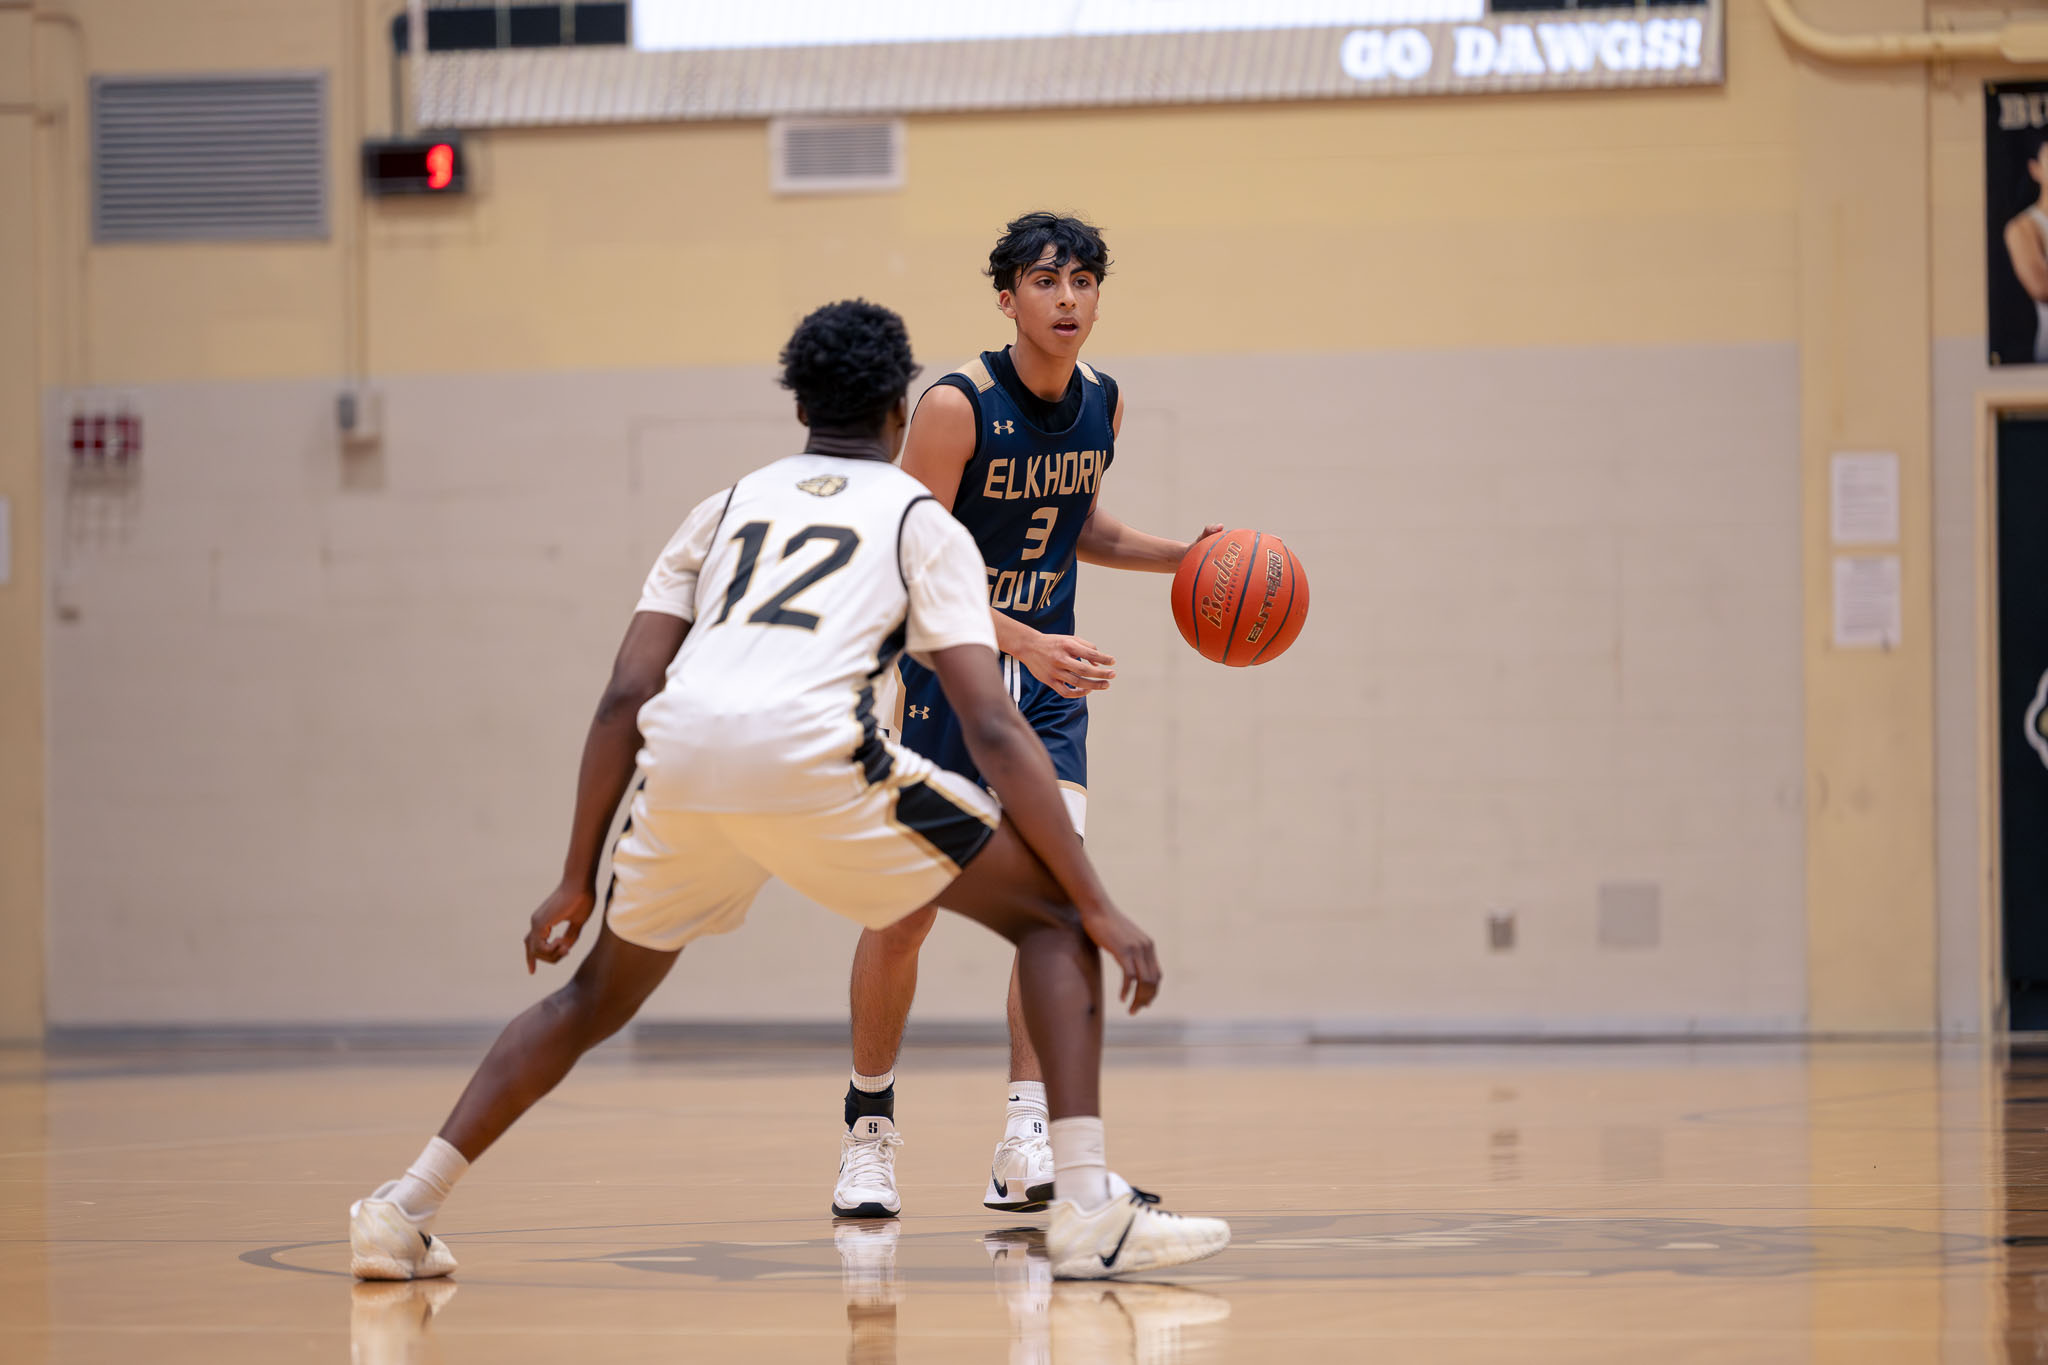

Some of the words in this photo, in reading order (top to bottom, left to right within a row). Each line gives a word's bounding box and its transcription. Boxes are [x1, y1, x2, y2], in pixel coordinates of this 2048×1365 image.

[1341, 29, 1432, 79] GO
[1452, 18, 1702, 76] DAWGS!
[983, 450, 1106, 499] ELKHORN
[1021, 507, 1059, 560] 3
[706, 520, 862, 633] 12
[1200, 541, 1243, 629] Baden
